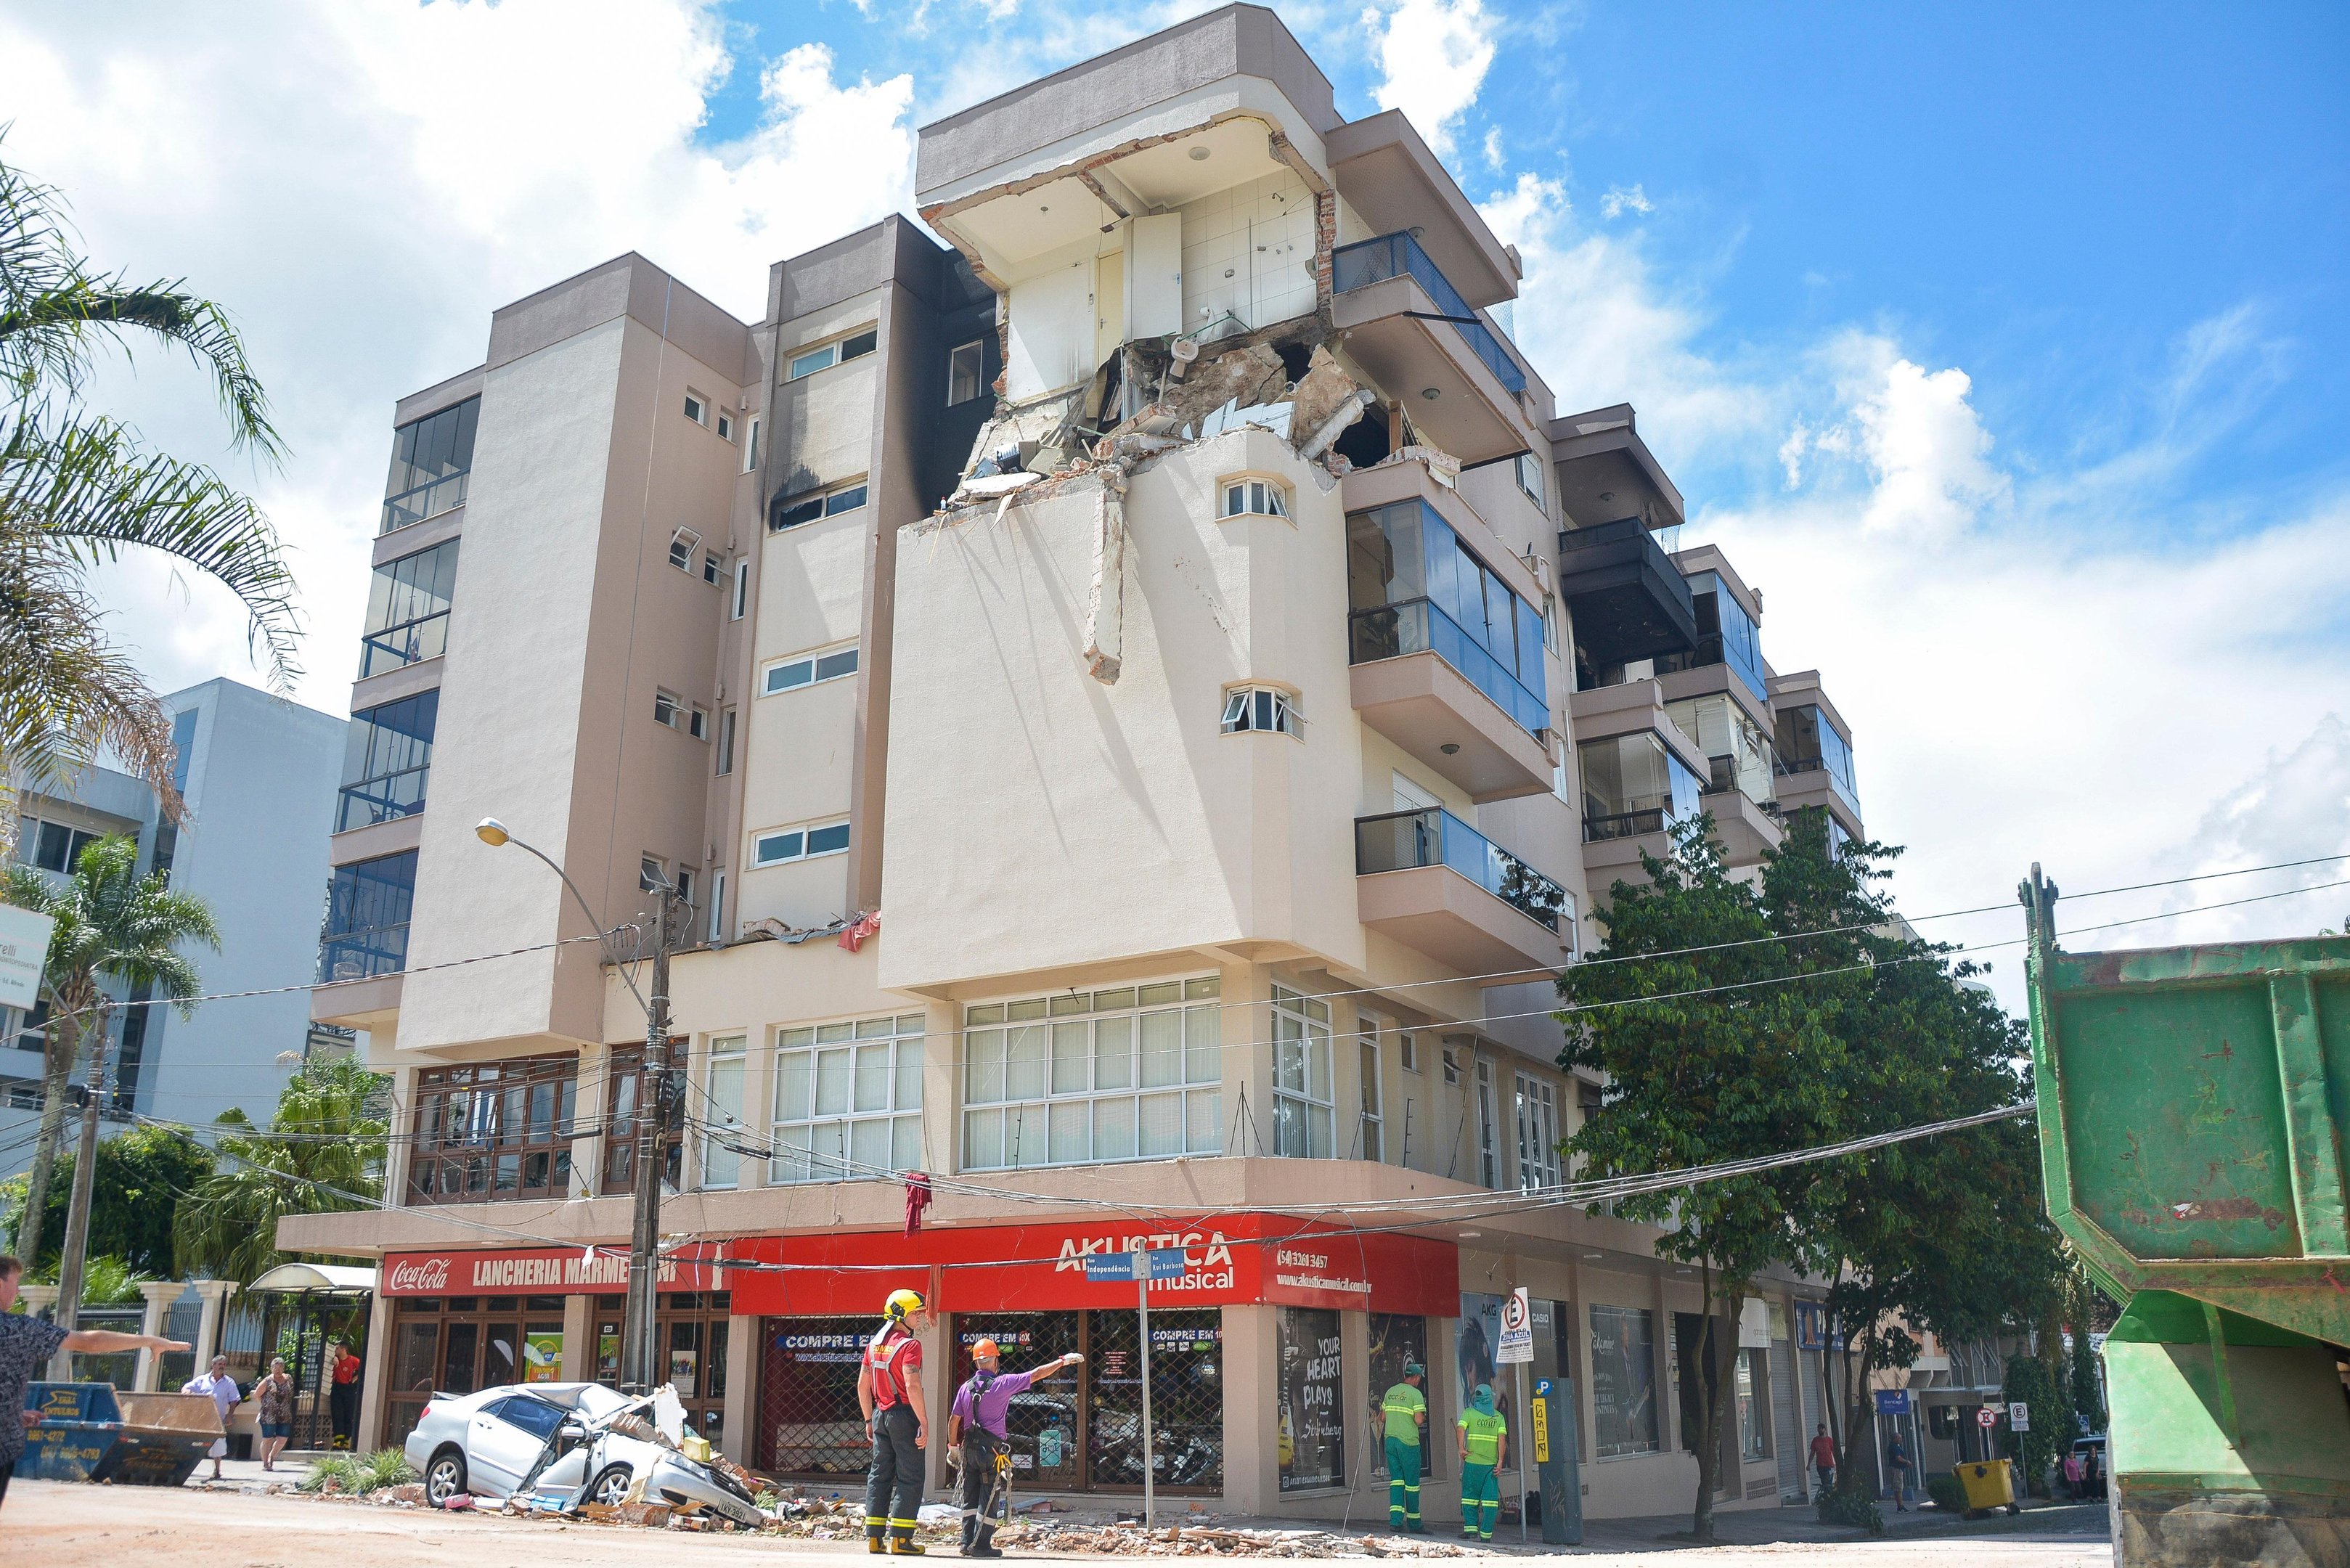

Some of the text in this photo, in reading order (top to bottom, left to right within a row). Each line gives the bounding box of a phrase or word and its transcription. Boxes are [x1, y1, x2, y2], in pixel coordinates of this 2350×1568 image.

[1277, 1249, 1328, 1268] (54) 3261 3457
[473, 1254, 677, 1286] LANCHERIA MARMENI
[1087, 1265, 1130, 1274] Independência
[1163, 1262, 1184, 1270] Barbosa
[391, 1258, 452, 1290] Coca-Cola
[1149, 1267, 1233, 1291] musical
[1276, 1273, 1372, 1293] www.akusticamusical.com.br
[1482, 1304, 1496, 1316] AKG
[1532, 1313, 1549, 1323] CASIO
[1003, 1333, 1016, 1342] EM
[1153, 1330, 1196, 1340] COMPRE
[1198, 1329, 1214, 1339] EM
[1502, 1333, 1514, 1342] ZA
[1514, 1331, 1530, 1339] AZUL
[786, 1335, 854, 1348] COMPRE
[1318, 1336, 1341, 1356] YOUR
[1307, 1356, 1341, 1381] HEART
[1541, 1381, 1549, 1392] P
[1303, 1385, 1333, 1410] PLAYS
[1595, 1405, 1615, 1414] ONTINUES
[2015, 1408, 2023, 1416] E
